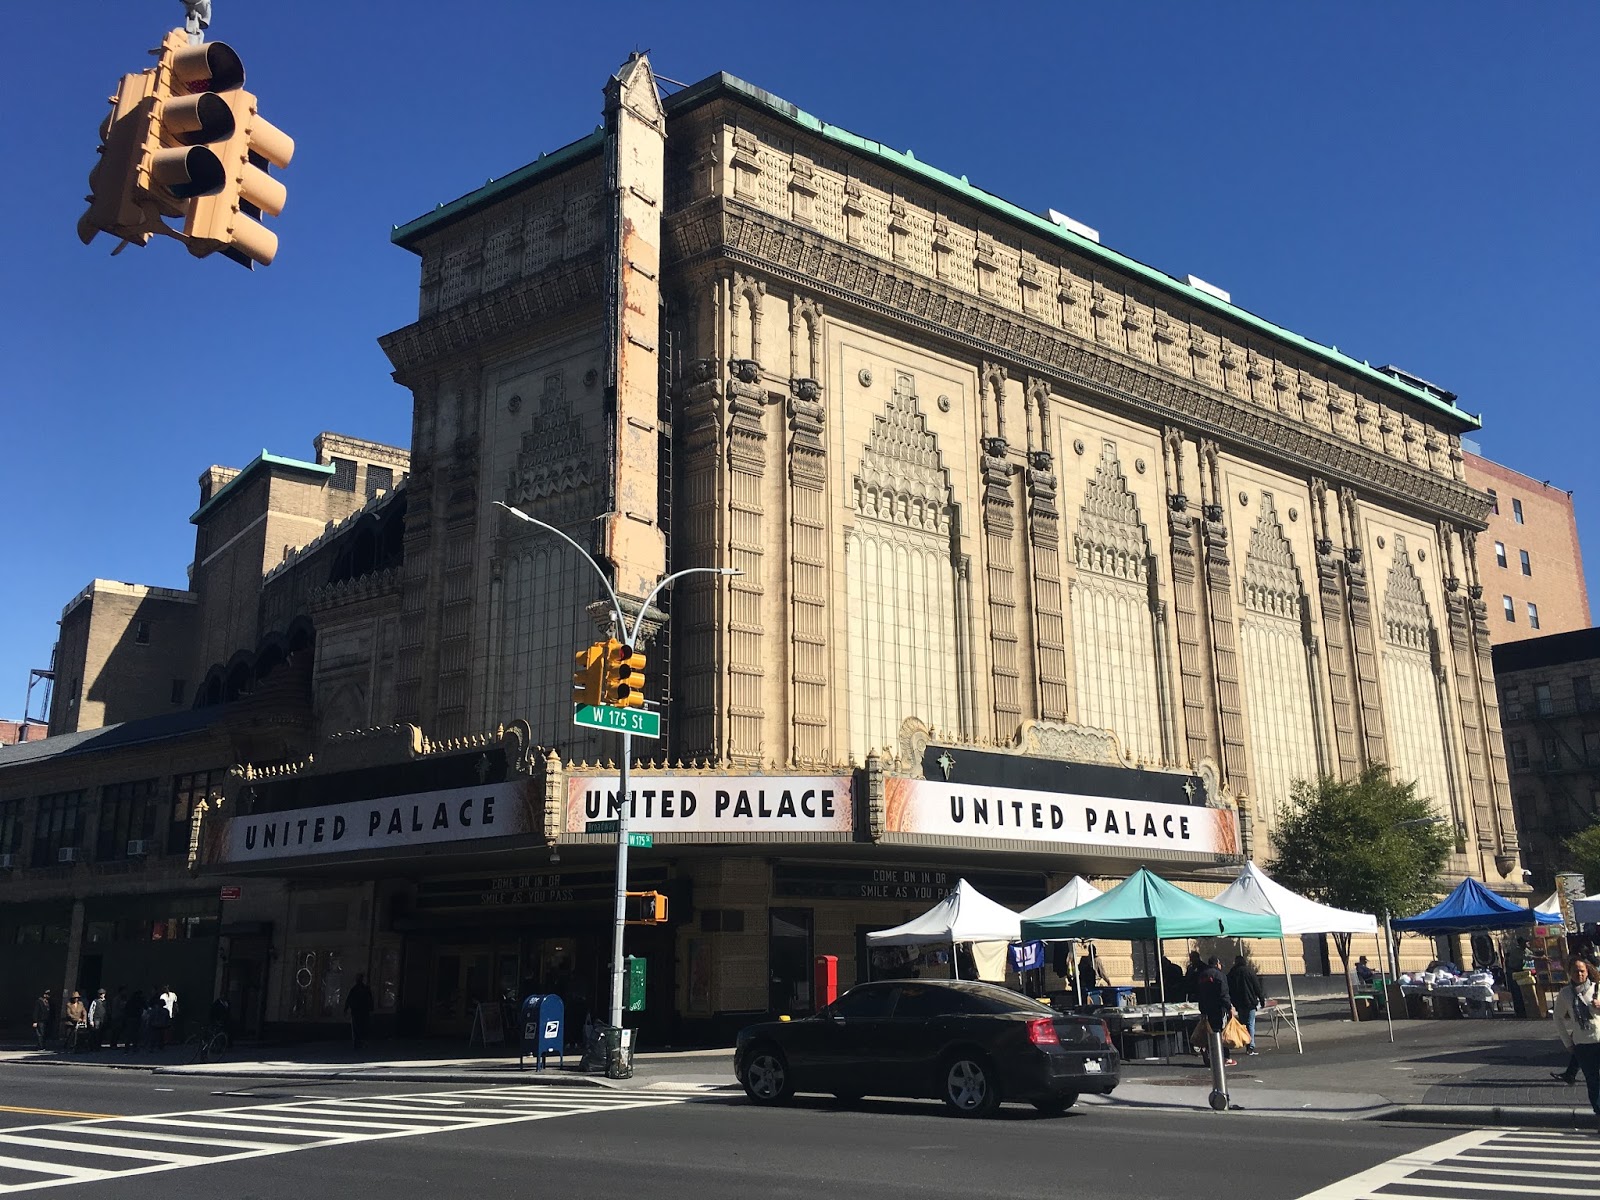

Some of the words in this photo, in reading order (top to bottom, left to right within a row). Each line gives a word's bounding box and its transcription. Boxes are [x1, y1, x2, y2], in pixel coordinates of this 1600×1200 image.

[593, 707, 604, 722] W
[608, 710, 627, 727] 175
[631, 714, 643, 729] St
[585, 790, 697, 818] UNITED
[715, 790, 835, 818] PALACE
[245, 815, 346, 850] UNITED
[368, 796, 495, 837] PALACE
[950, 795, 1064, 829] UNITED
[1085, 807, 1190, 840] PALACE
[629, 835, 635, 845] W
[636, 835, 645, 846] 175
[492, 877, 514, 890] COME
[519, 876, 530, 887] ON
[534, 875, 543, 886] IN
[548, 874, 560, 886] OR
[873, 869, 898, 882] COME
[903, 871, 916, 883] ON
[921, 872, 930, 884] IN
[935, 873, 946, 884] OR
[480, 892, 506, 905] SMILE
[512, 891, 523, 903] AS
[528, 890, 546, 902] YOU
[550, 889, 575, 901] PASS
[860, 885, 889, 897] SMILE
[895, 886, 907, 898] AS
[914, 887, 932, 899] YOU
